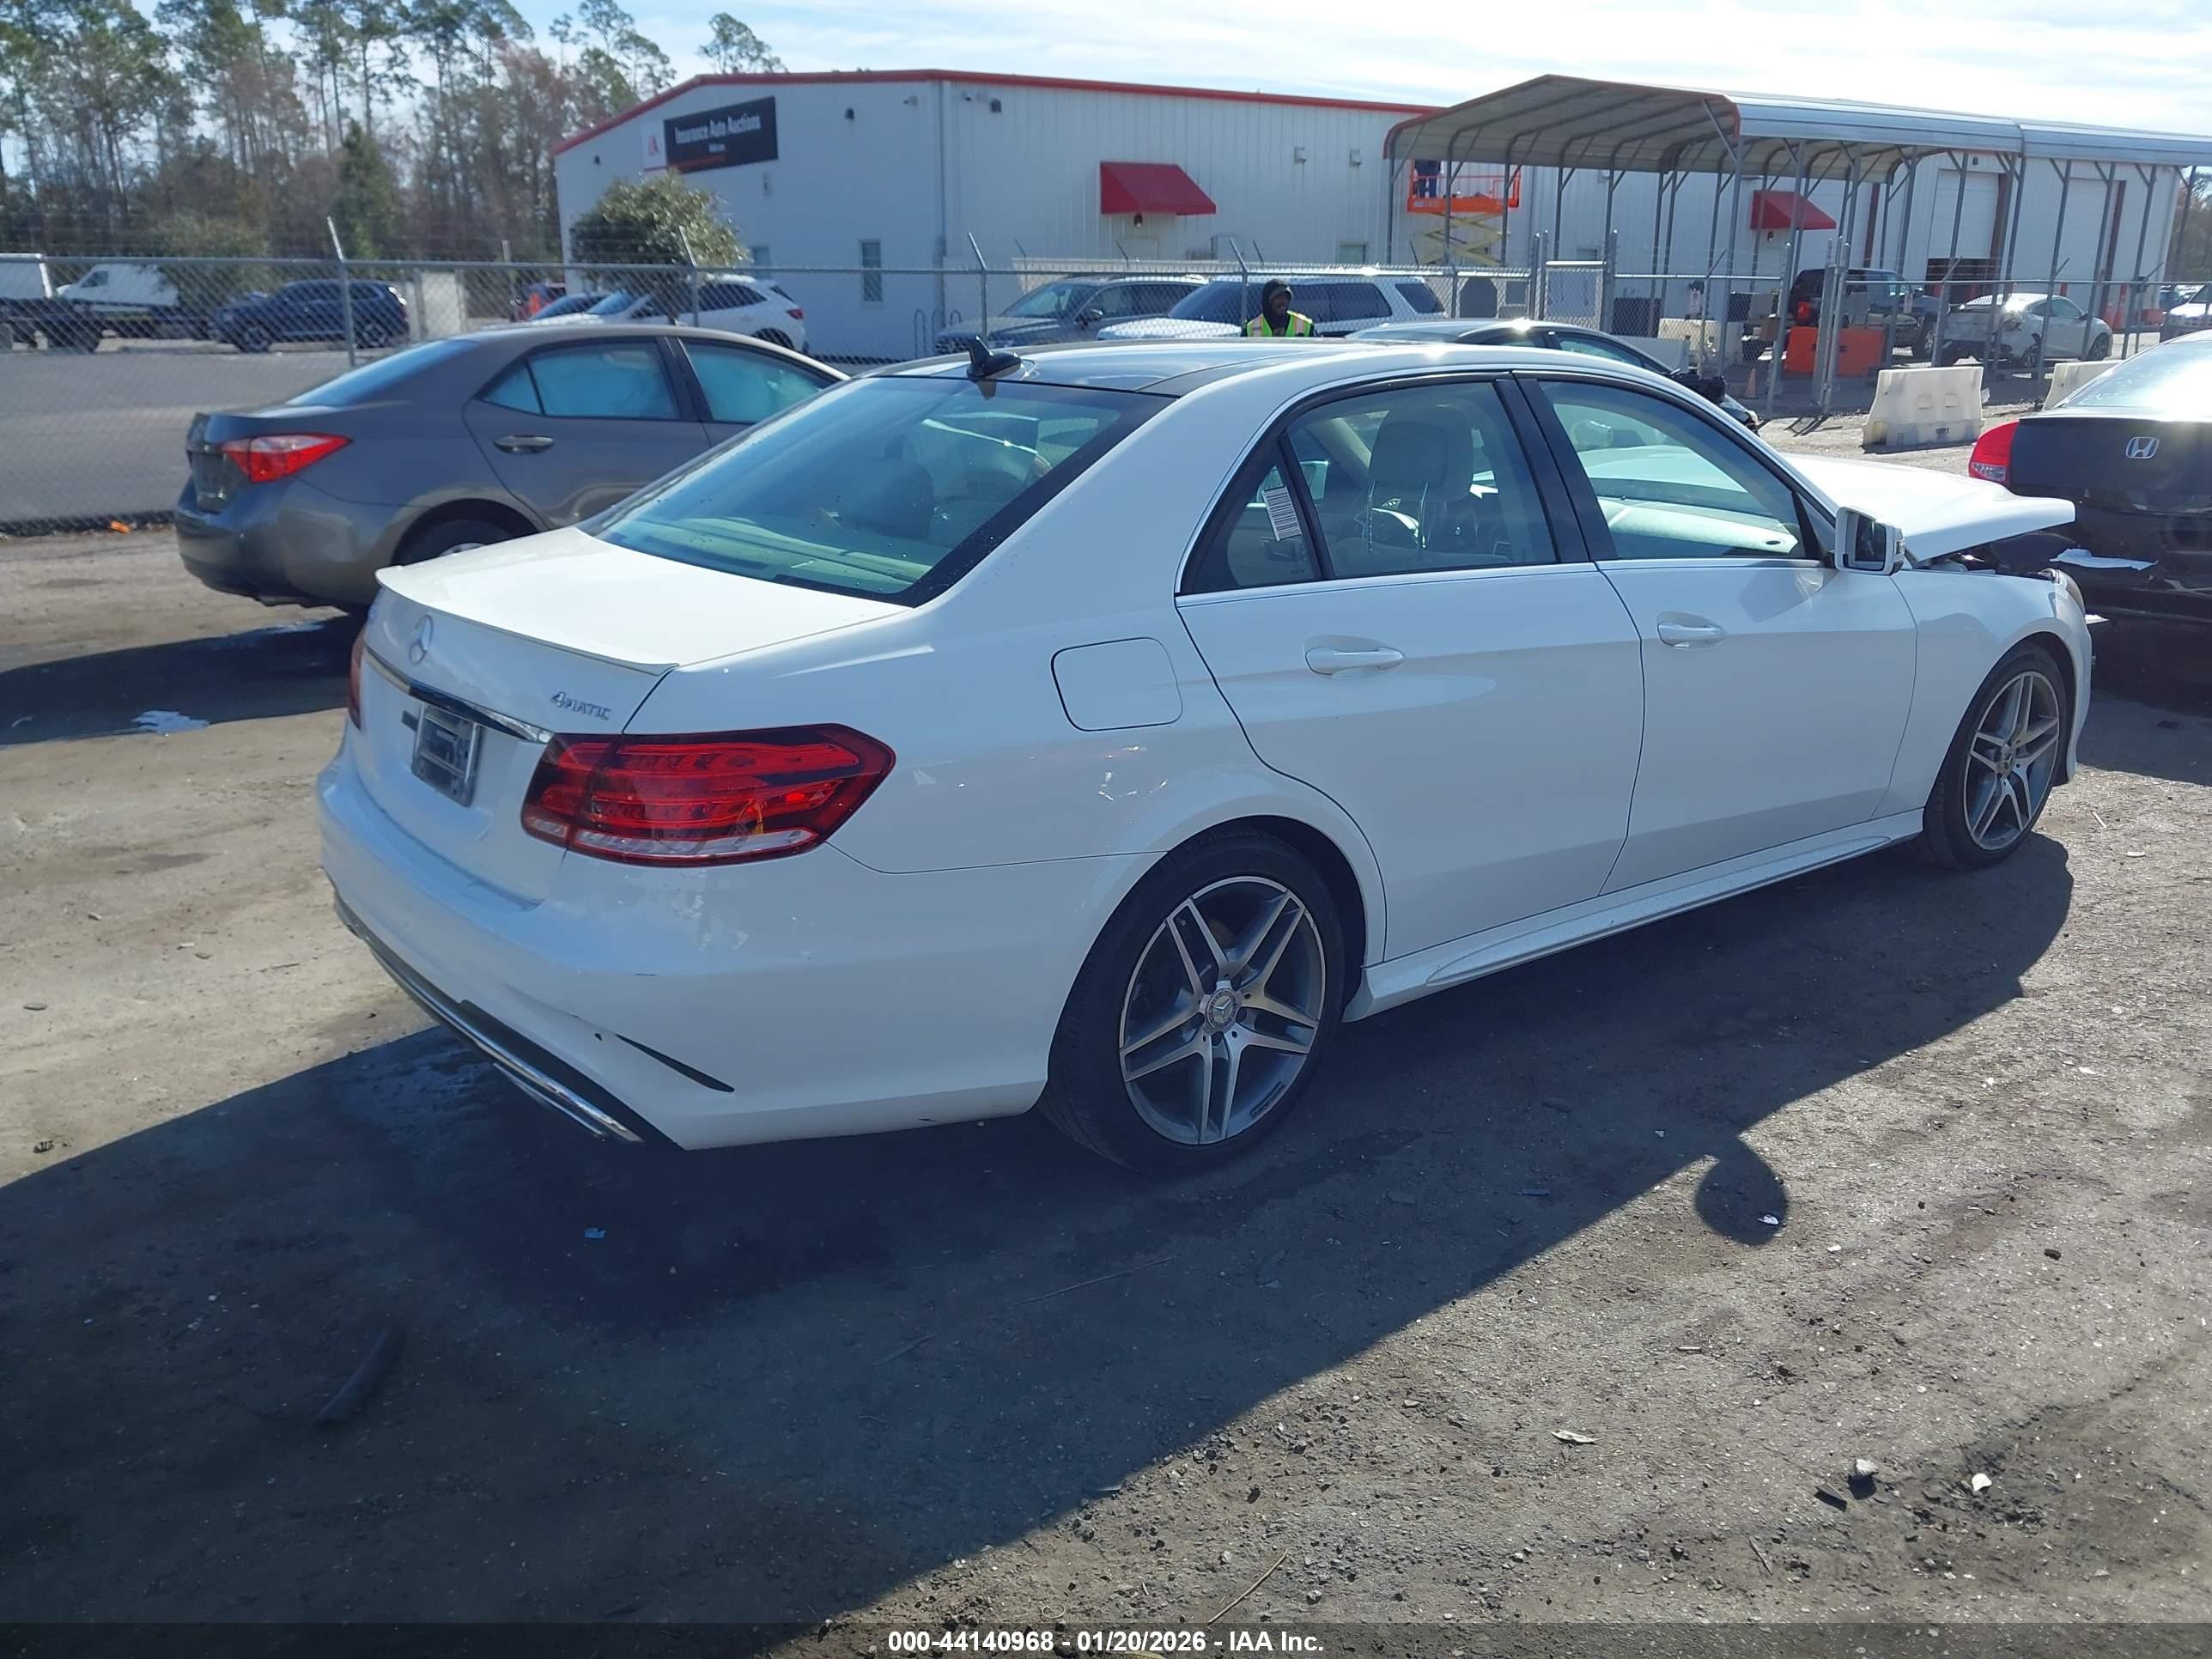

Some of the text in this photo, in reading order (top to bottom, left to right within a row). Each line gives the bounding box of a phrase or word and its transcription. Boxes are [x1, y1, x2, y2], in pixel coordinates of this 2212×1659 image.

[709, 119, 726, 137] Auto
[726, 112, 762, 135] Auctions
[550, 690, 612, 721] 4MATIC
